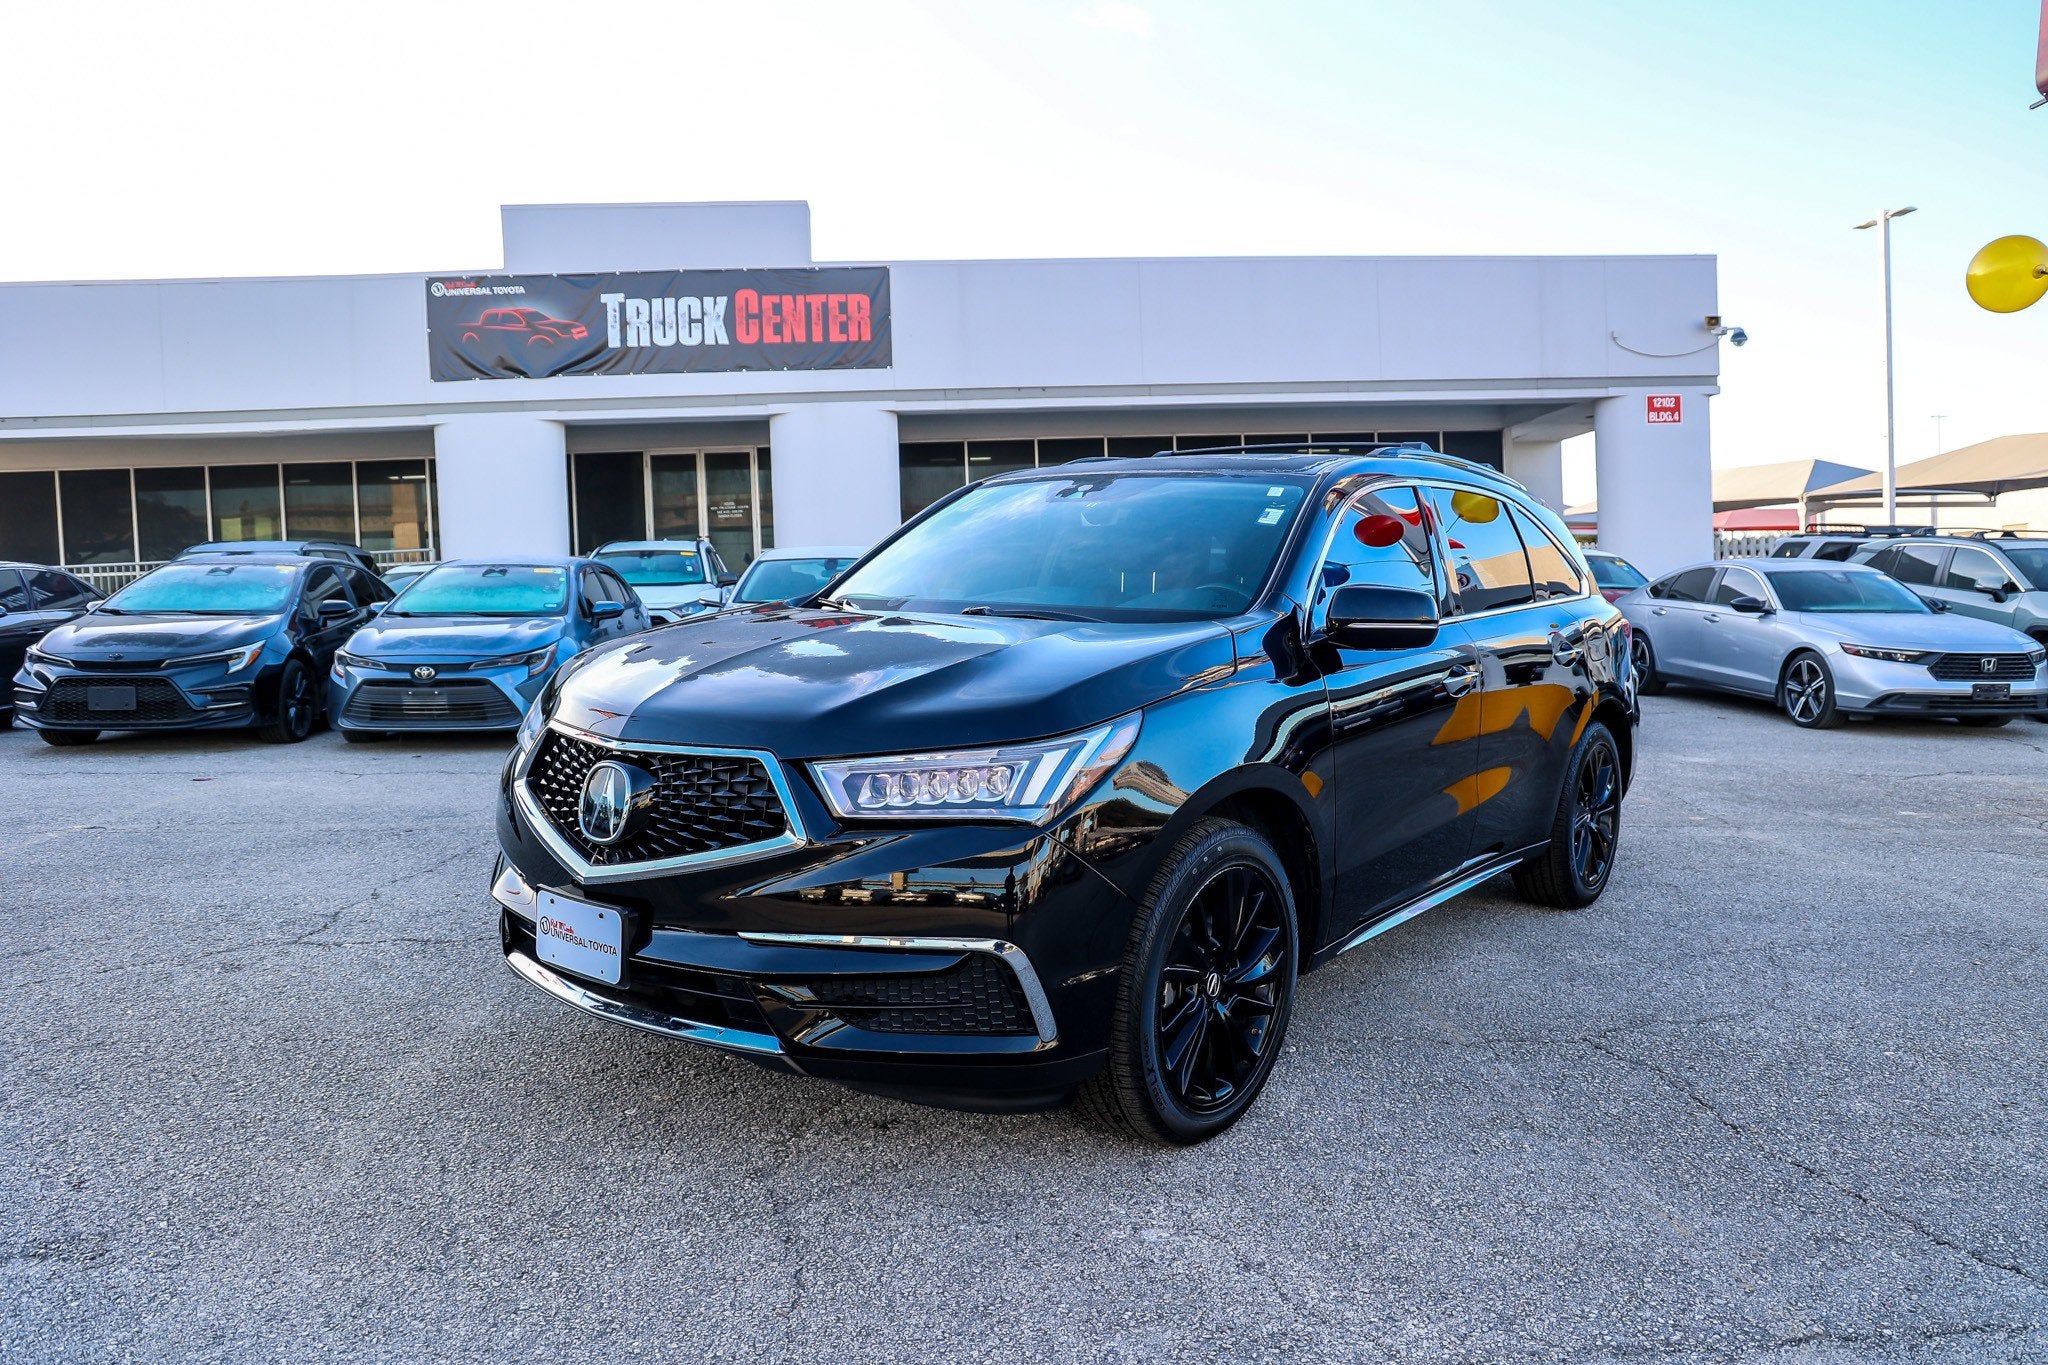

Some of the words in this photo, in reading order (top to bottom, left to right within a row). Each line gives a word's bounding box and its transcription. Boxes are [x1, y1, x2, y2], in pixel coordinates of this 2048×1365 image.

[444, 287, 493, 297] UNIVERSAL
[493, 286, 526, 295] TOYOTA
[600, 293, 730, 348] TRUCK
[735, 288, 871, 344] CENTER
[1652, 397, 1676, 408] 12102
[550, 928, 588, 948] UNIVERSAL
[588, 940, 618, 957] TOYOTA
